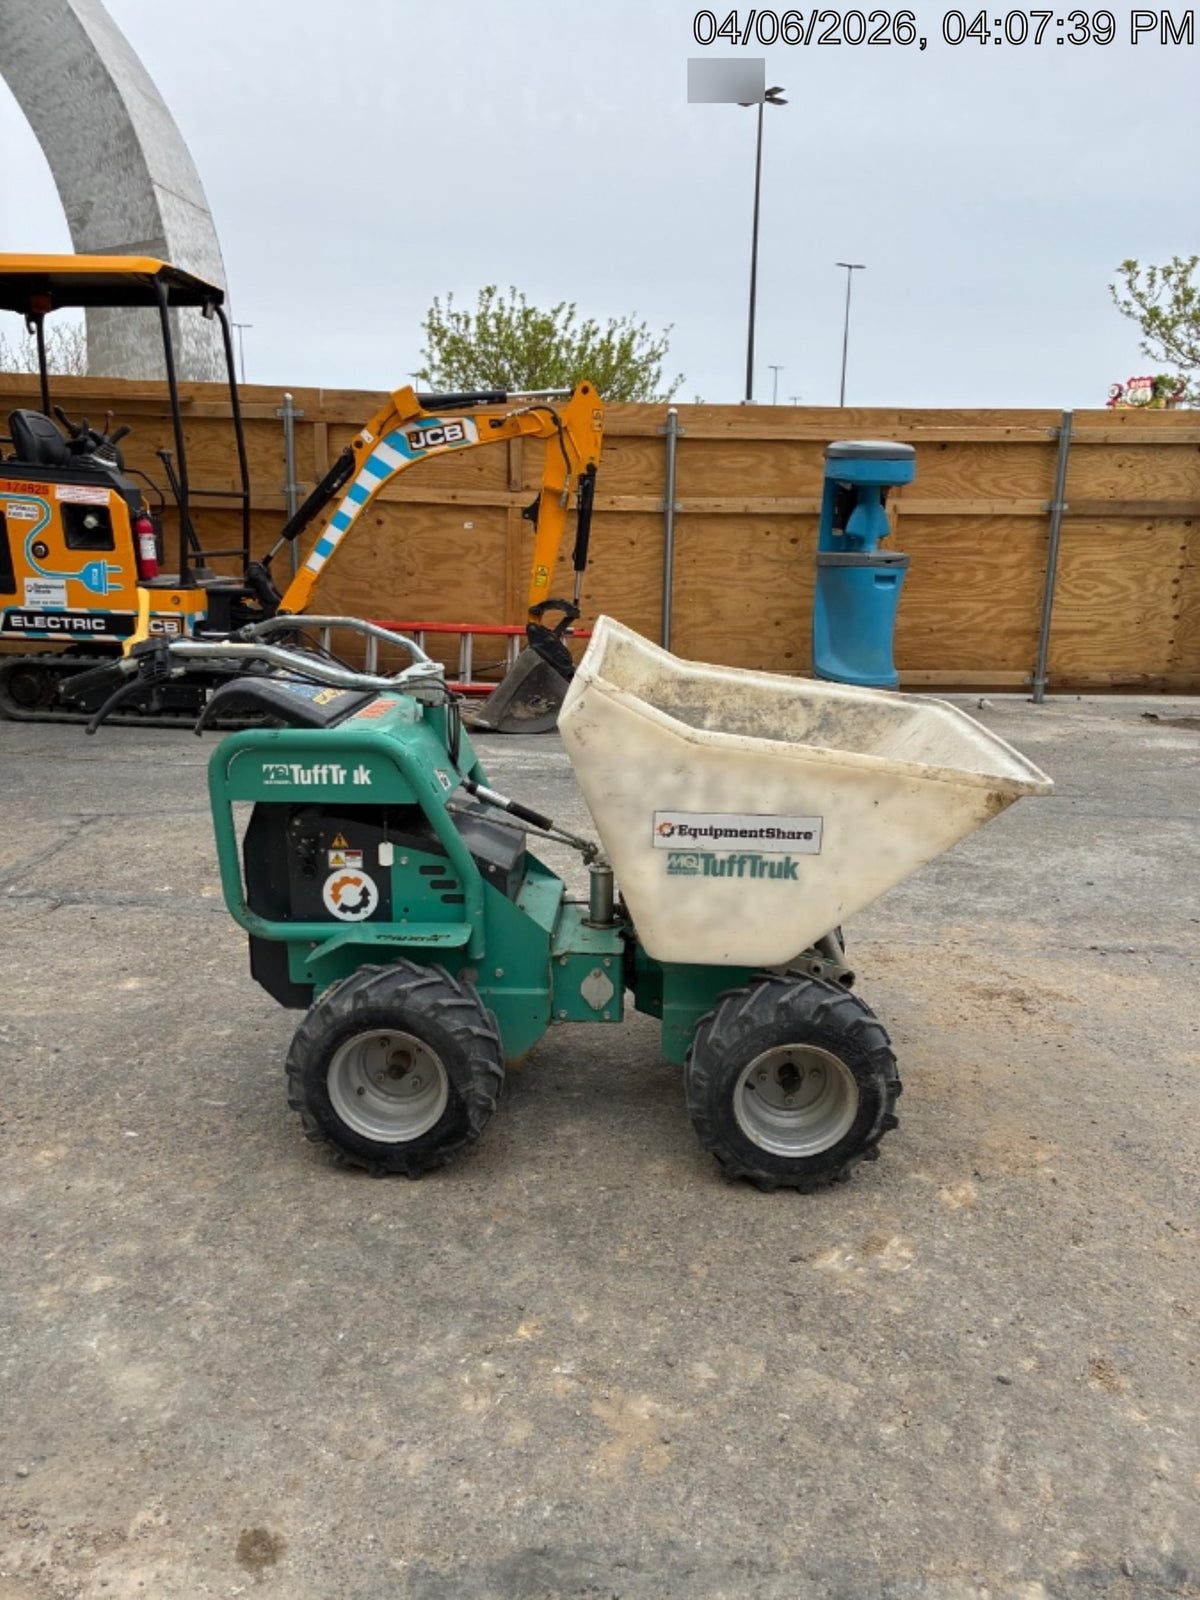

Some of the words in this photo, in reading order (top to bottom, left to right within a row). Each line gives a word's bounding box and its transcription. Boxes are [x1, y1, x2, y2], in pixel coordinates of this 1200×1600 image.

[410, 425, 464, 449] JCB
[10, 615, 106, 631] ELECTRIC
[149, 621, 179, 633] CB
[677, 823, 814, 841] EquipmentShare
[700, 853, 800, 881] TuffTruk
